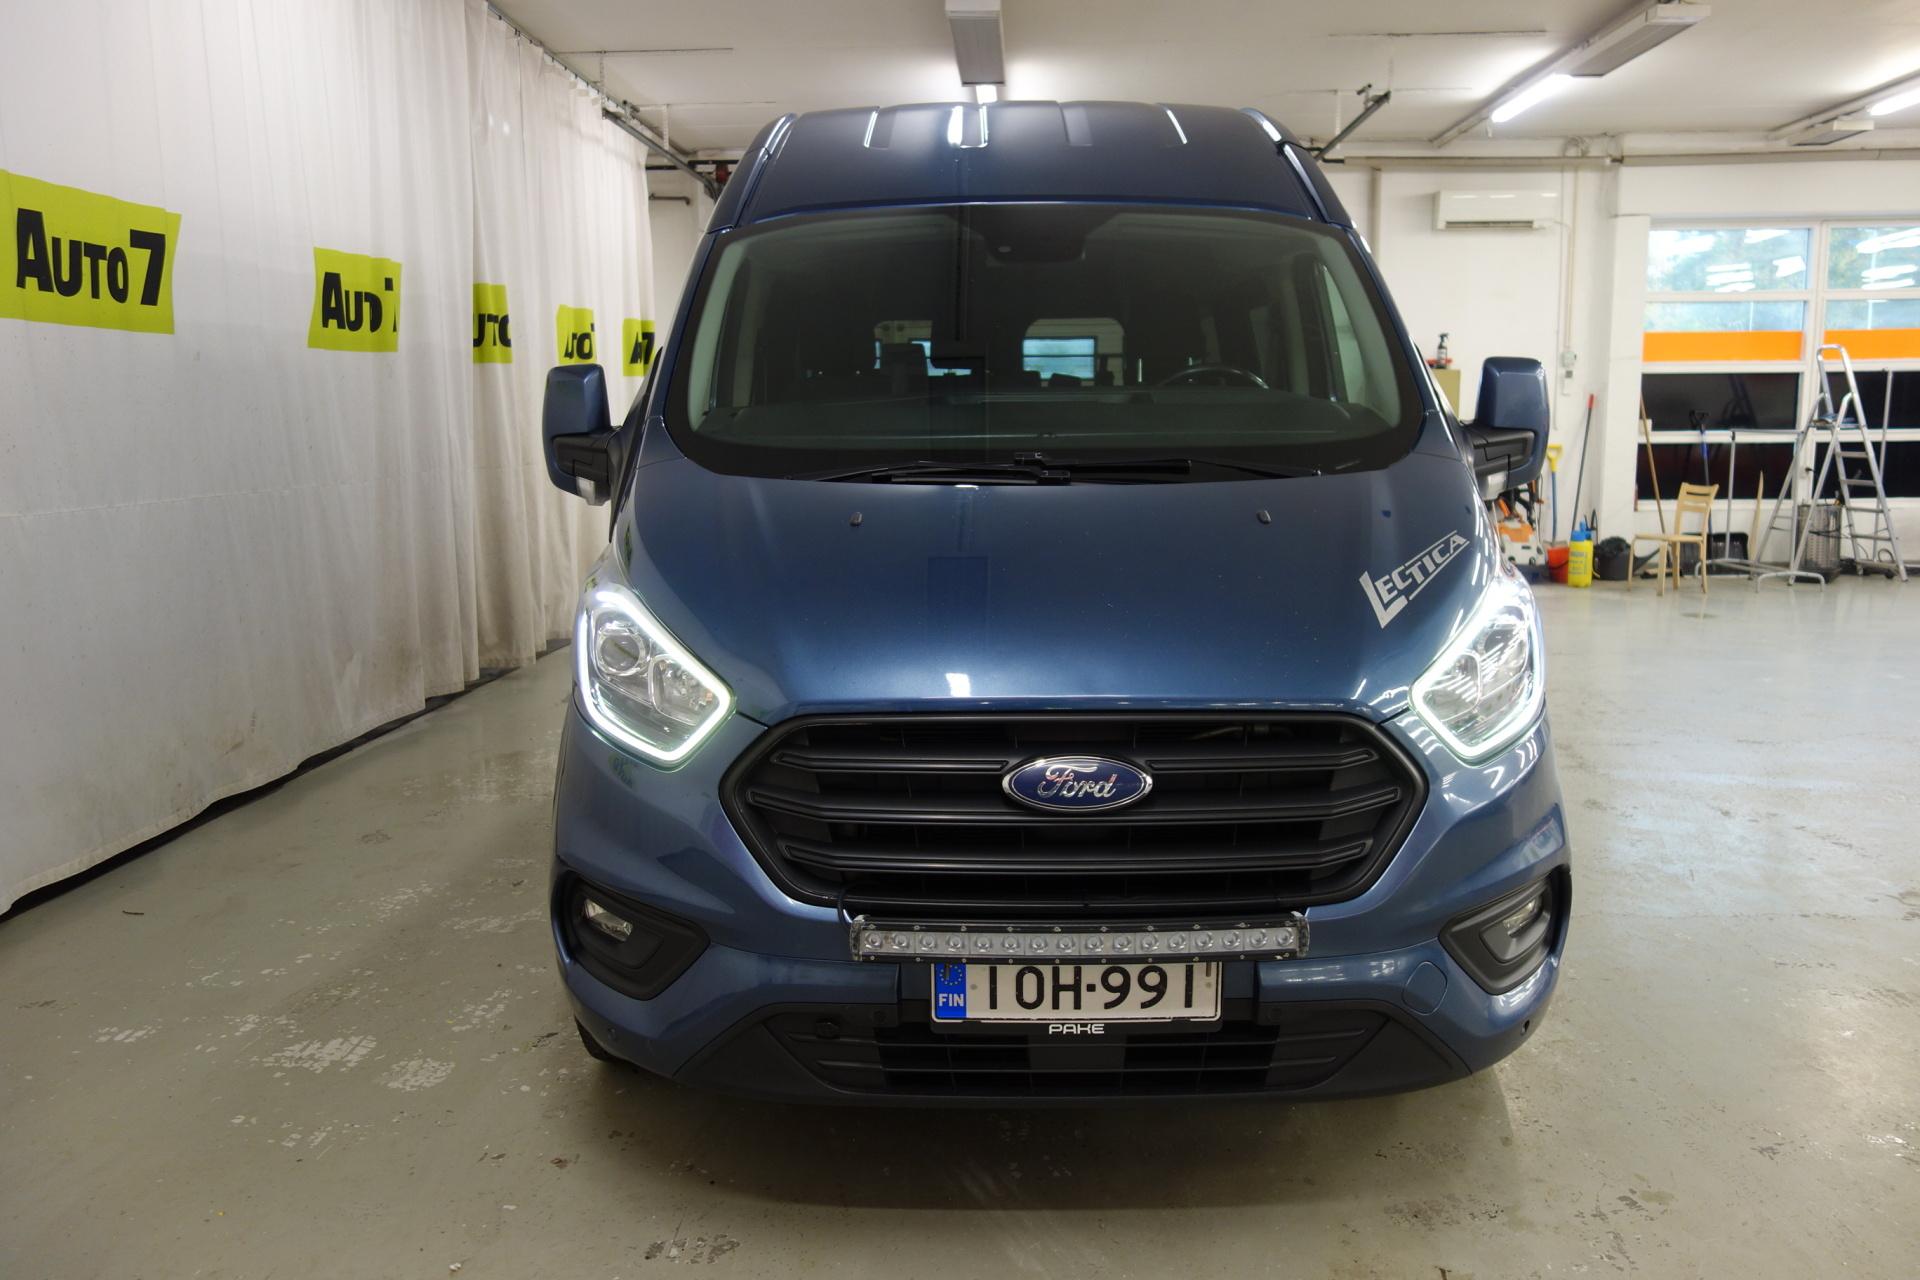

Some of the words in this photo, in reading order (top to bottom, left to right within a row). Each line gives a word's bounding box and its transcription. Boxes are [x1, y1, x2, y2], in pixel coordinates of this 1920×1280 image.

[1359, 533, 1468, 629] LECTICA
[1037, 763, 1117, 799] Ford
[938, 993, 965, 1007] FIN
[989, 965, 1194, 1010] IOH-991
[1048, 1023, 1105, 1035] PAKE
